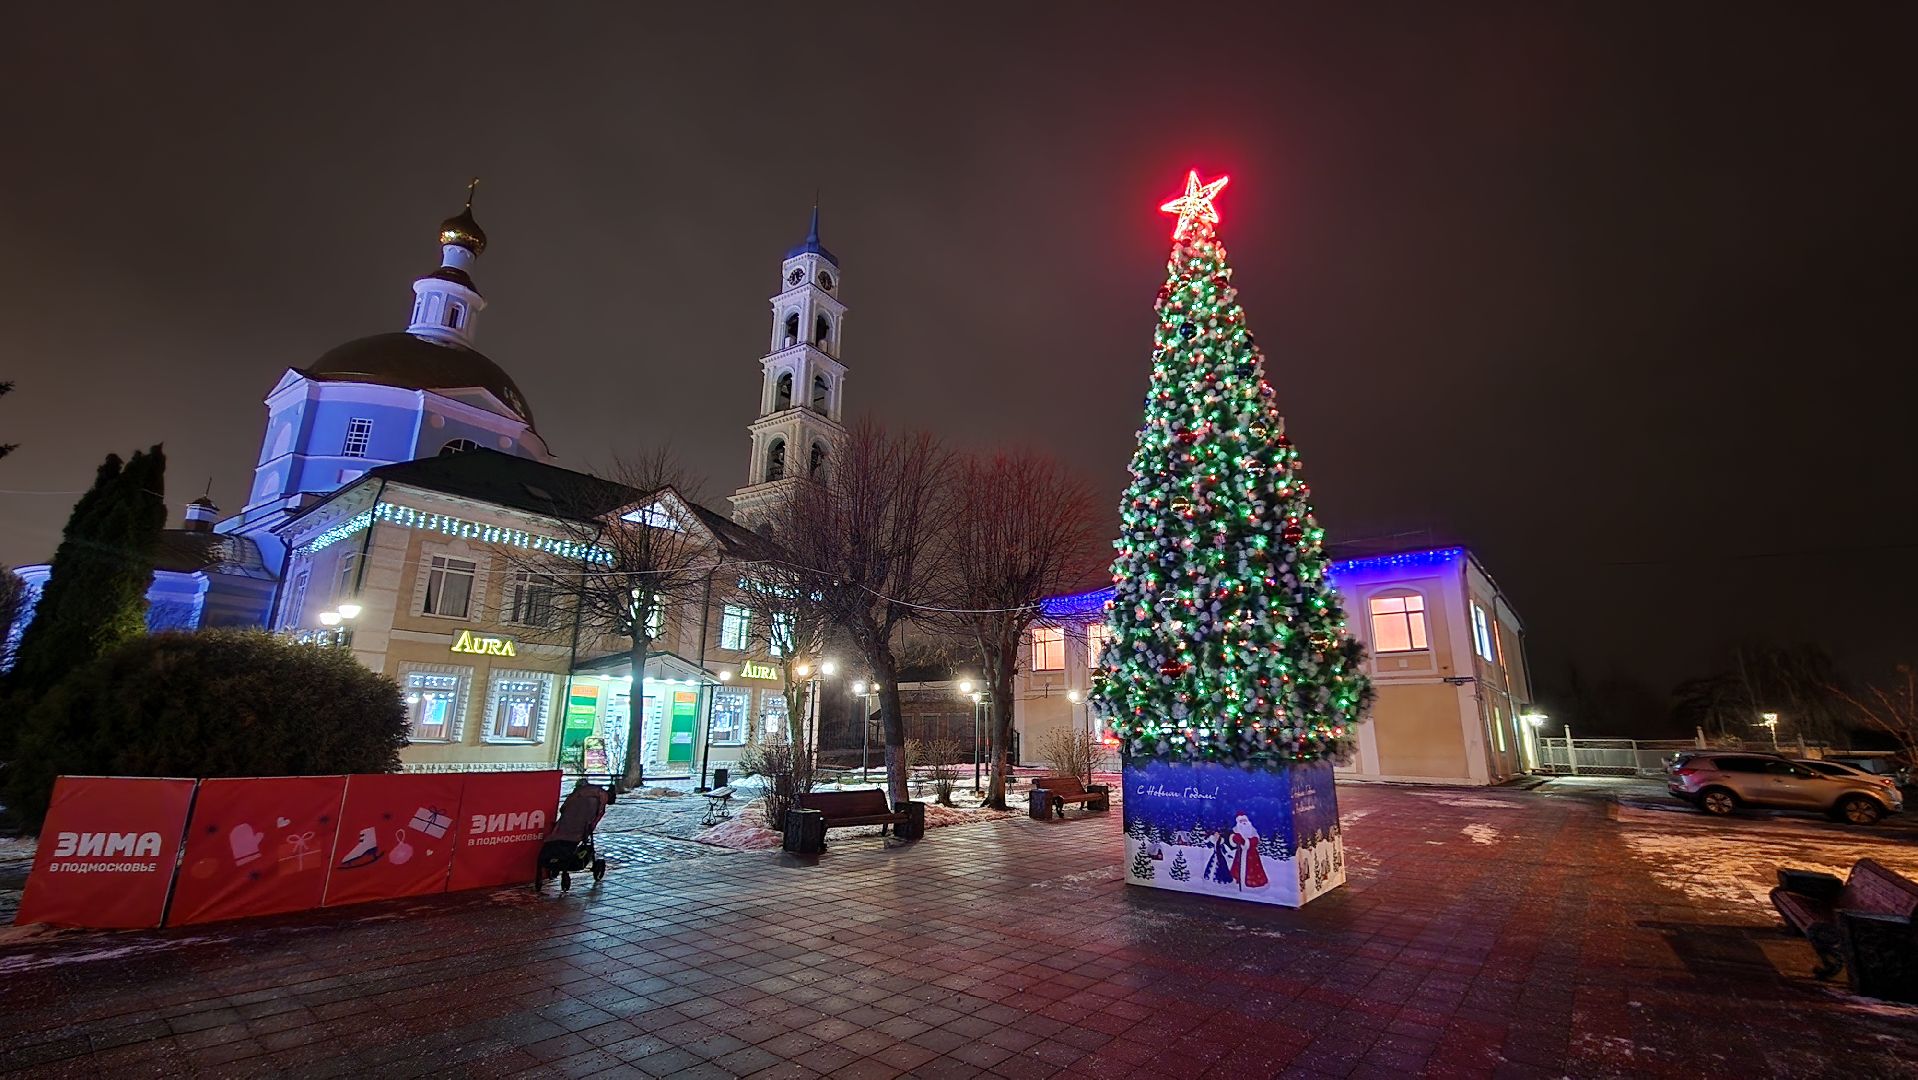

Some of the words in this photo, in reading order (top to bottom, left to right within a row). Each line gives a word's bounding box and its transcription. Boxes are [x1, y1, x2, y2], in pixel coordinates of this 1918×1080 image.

[451, 630, 516, 657] AURA
[470, 809, 546, 834] ЗИМА
[54, 831, 162, 857] ЗИМА
[475, 832, 544, 846] ПОДМОСКОВЬЕ
[61, 862, 157, 873] ПОДМОСКОВЬЕ
